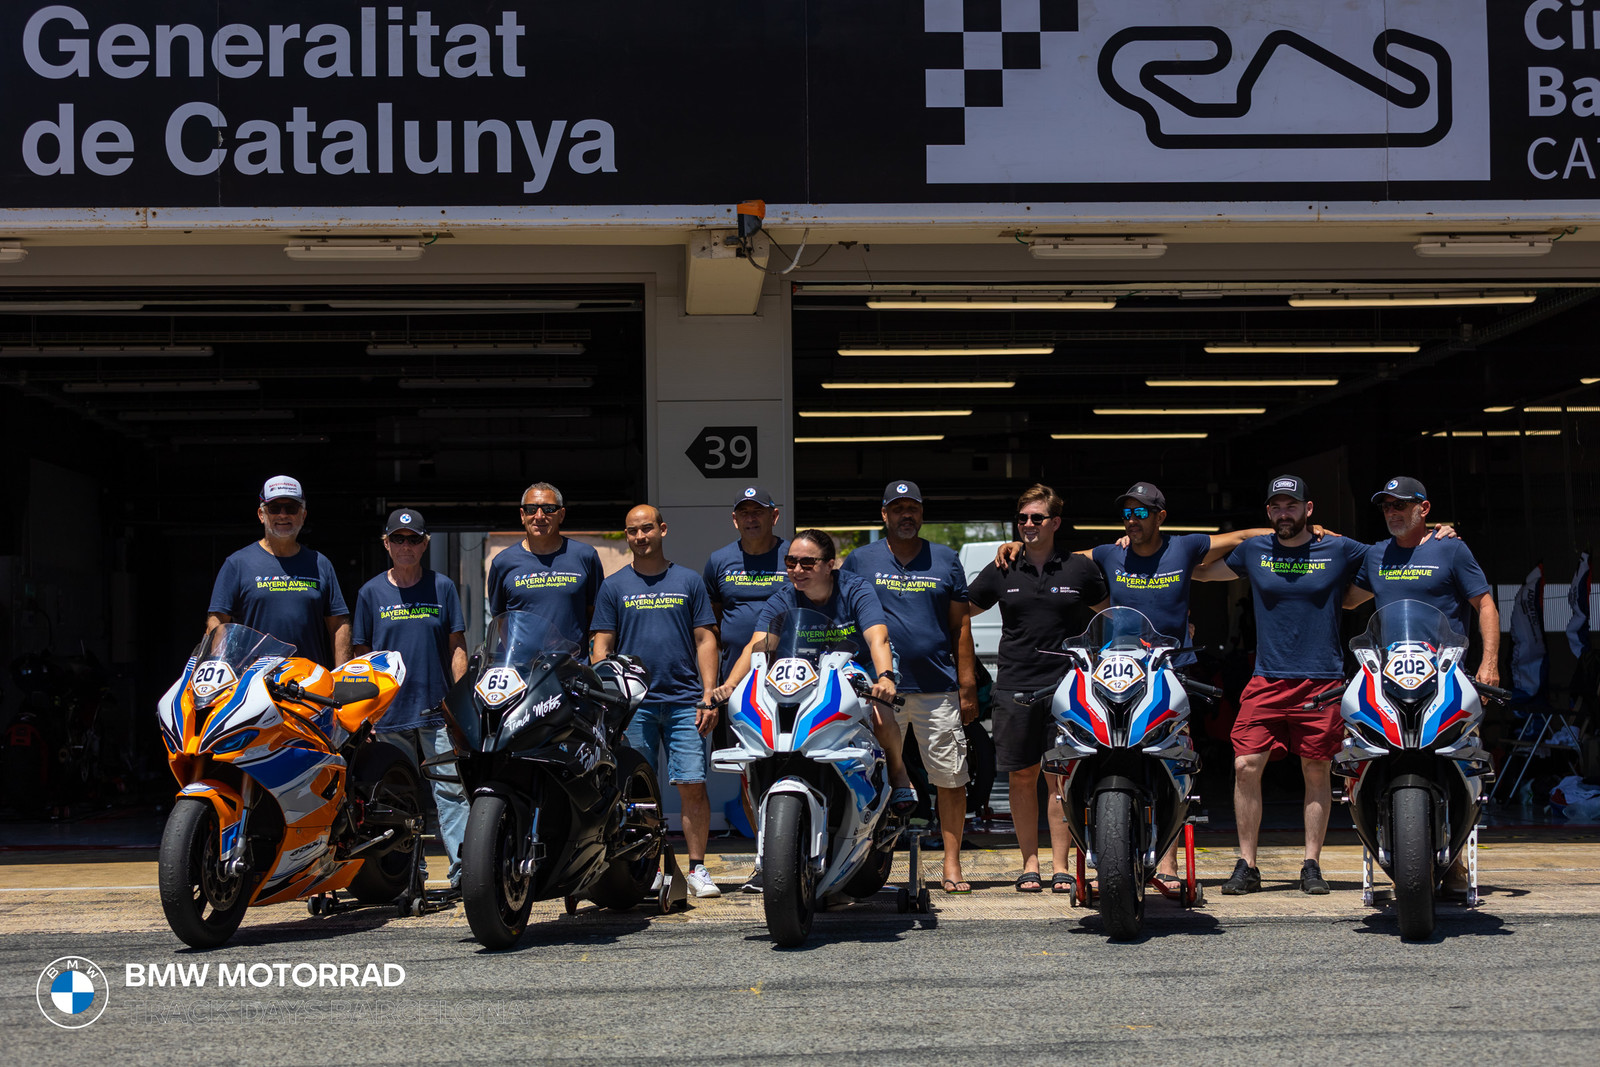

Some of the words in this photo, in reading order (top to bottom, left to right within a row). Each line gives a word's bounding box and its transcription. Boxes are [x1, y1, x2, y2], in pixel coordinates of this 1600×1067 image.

[22, 5, 526, 79] Generalitat
[22, 103, 135, 176] de
[164, 101, 618, 194] Catalunya
[1527, 137, 1600, 180] CA
[704, 435, 752, 470] 39
[1261, 561, 1290, 569] BAYERN
[1292, 562, 1325, 570] AVENUE
[288, 580, 317, 588] AVENUE
[515, 577, 545, 587] BAYERN
[906, 581, 936, 589] AVENUE
[1116, 575, 1147, 585] BAYERN
[1148, 575, 1180, 585] AVENUE
[625, 599, 654, 608] BAYERN
[655, 597, 684, 605] AVENUE
[381, 609, 410, 619] BAYERN
[825, 626, 857, 637] AVENUE
[195, 667, 225, 683] 201
[775, 665, 807, 681] 203
[1103, 663, 1134, 680] 204
[1394, 659, 1426, 676] 202
[488, 674, 509, 690] 65
